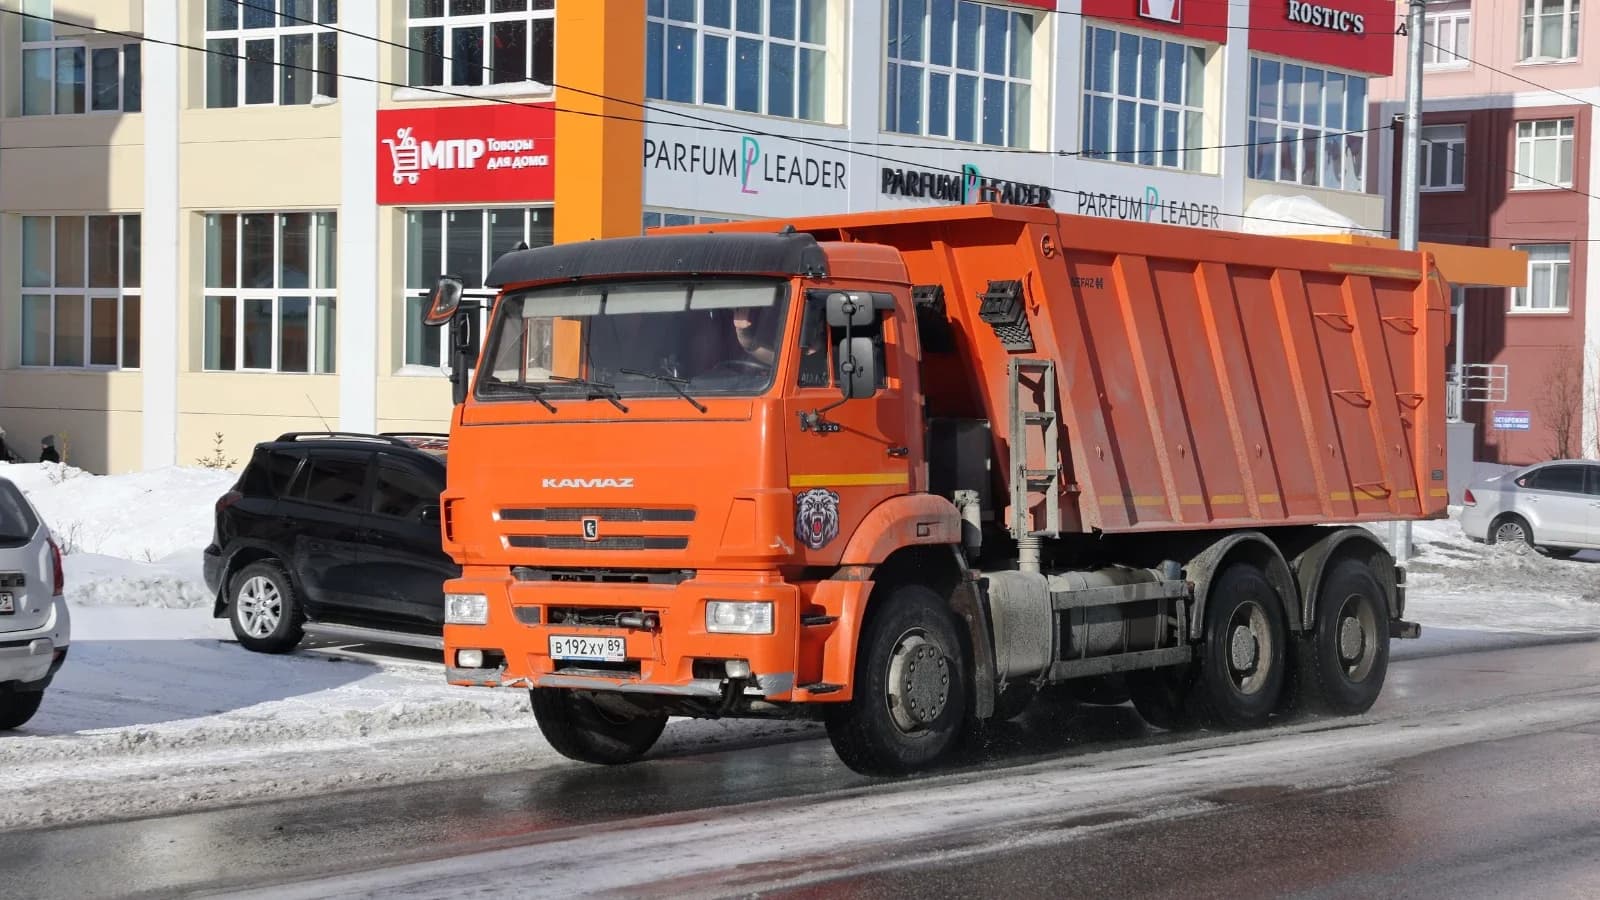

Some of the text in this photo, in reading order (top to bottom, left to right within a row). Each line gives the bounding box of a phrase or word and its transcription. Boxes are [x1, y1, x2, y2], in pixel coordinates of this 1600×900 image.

[1287, 0, 1364, 34] ROSTIC'S
[421, 139, 484, 170] МПР
[487, 138, 534, 153] Товары
[487, 155, 549, 170] для дома
[644, 138, 737, 177] PARFUM
[764, 153, 847, 189] LEADER
[881, 167, 961, 202] PARFUM
[979, 177, 1054, 208] LEADER
[1078, 190, 1143, 221] PARFUM
[1161, 199, 1220, 228] LEADER
[542, 478, 635, 488] KAMAZ
[607, 639, 621, 652] 89
